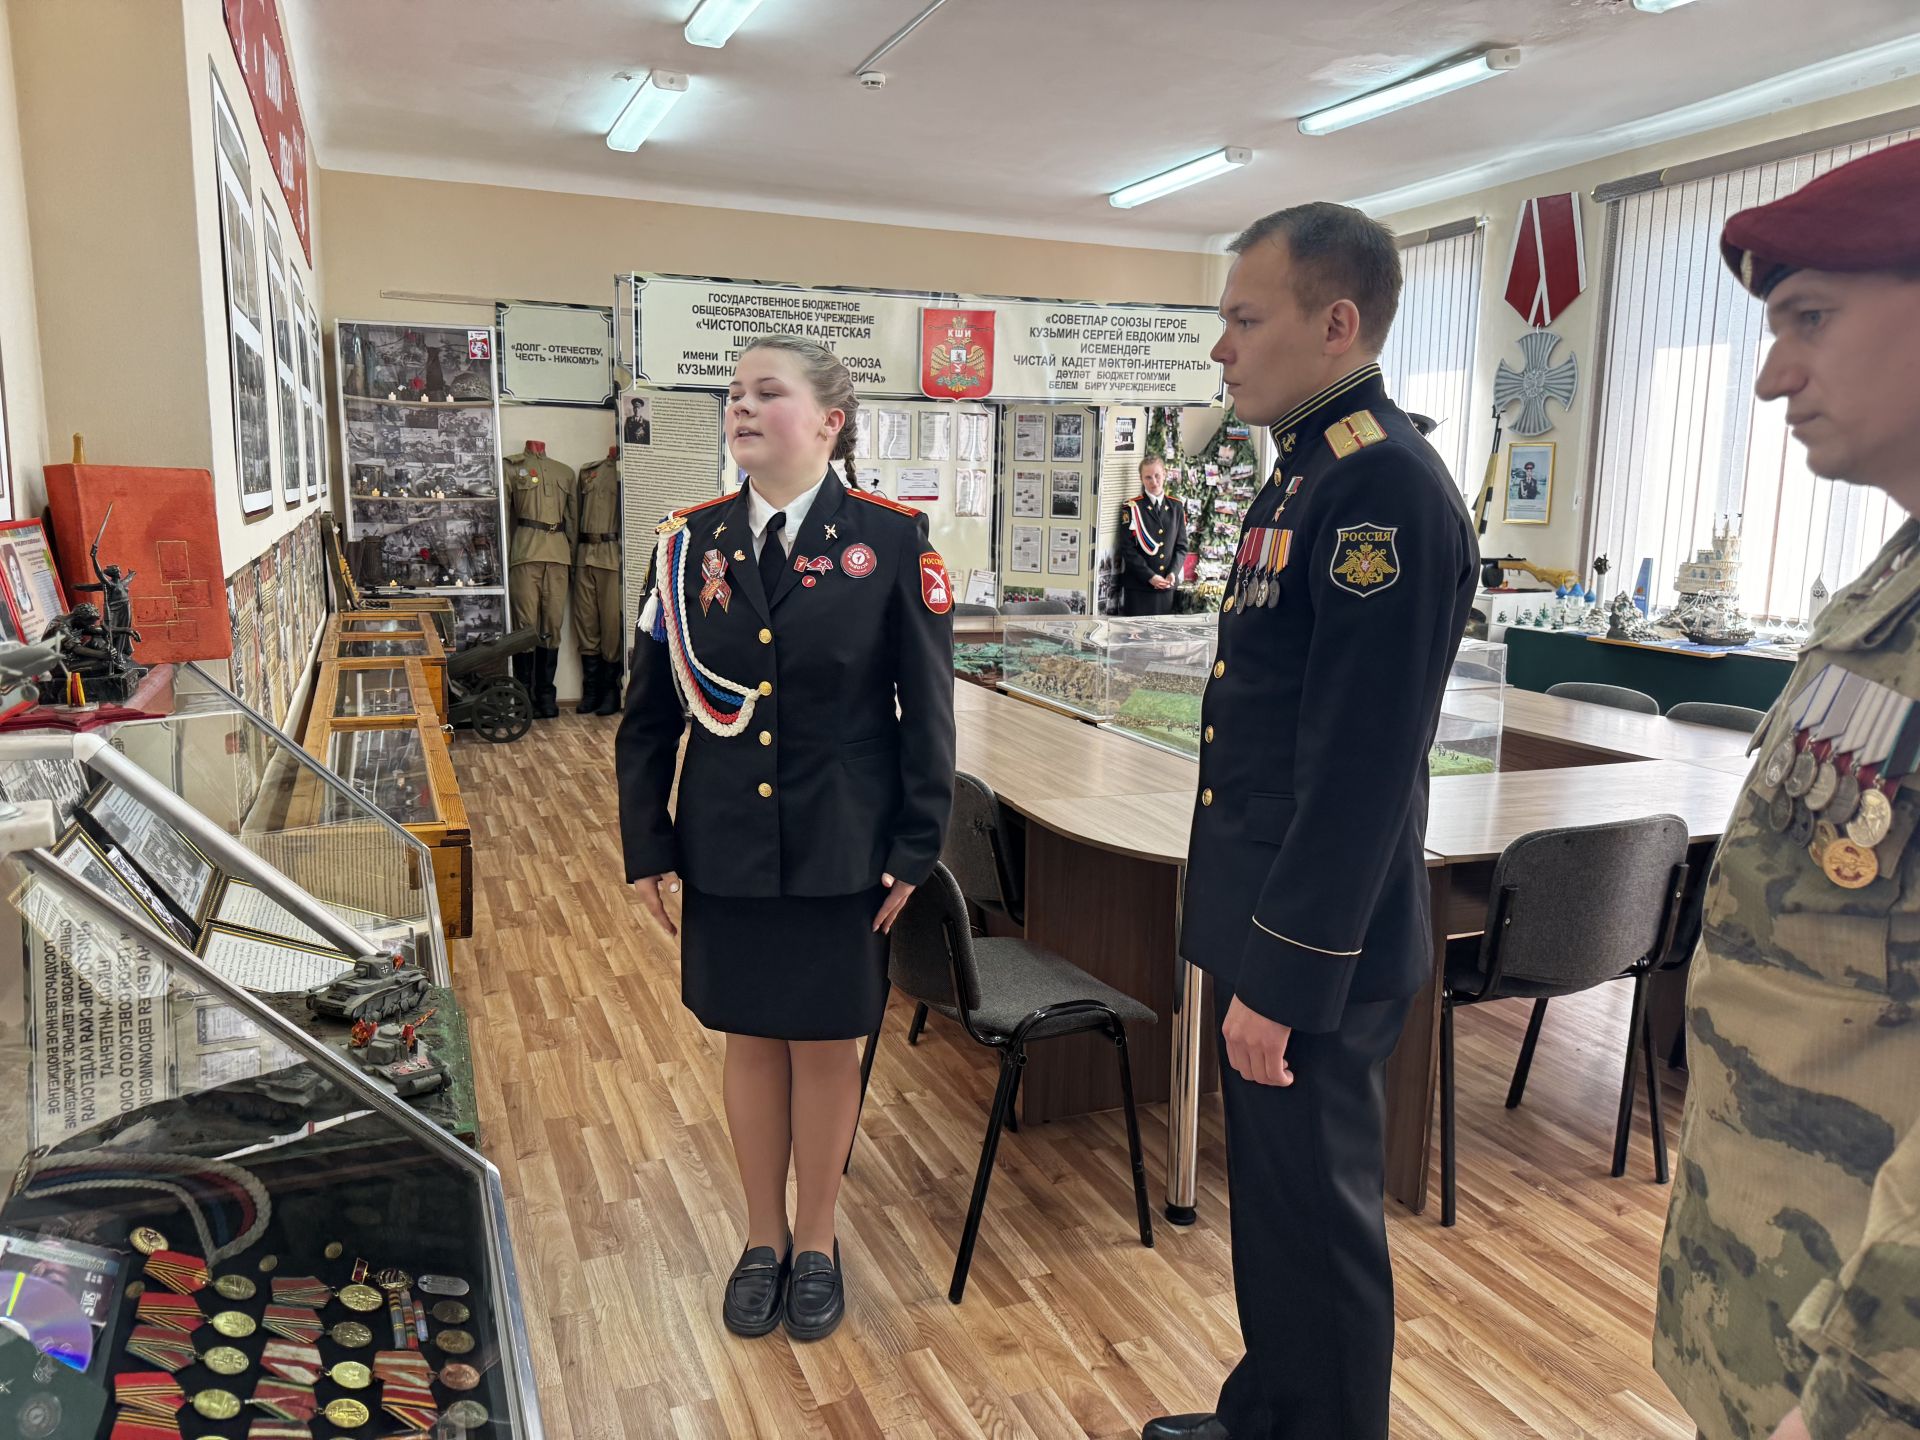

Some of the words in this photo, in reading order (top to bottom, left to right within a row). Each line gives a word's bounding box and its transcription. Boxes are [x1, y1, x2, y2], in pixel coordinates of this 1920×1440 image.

[708, 293, 800, 308] ГОСУДАРСТВЕННОЕ
[803, 299, 861, 312] БЮДЖЕТНОЕ
[692, 305, 813, 321] ОБЩЕОБРАЗОВАТЕЛЬНОЕ
[814, 312, 875, 325] УЧРЕЖДЕНИЕ
[1045, 313, 1108, 326] «СОВЕТЛАР
[1110, 316, 1152, 328] СОЮЗЫ
[1154, 318, 1187, 329] ГЕРОЕ
[696, 318, 804, 335] «ЧИСТОПОЛЬСКАЯ
[806, 325, 871, 339] КАДЕТСКАЯ
[947, 329, 972, 338] КШИ
[1029, 327, 1080, 339] КУЗЬМИН
[1082, 327, 1123, 341] СЕРГЕЙ
[1126, 331, 1176, 344] ЕВДОКИМ
[1178, 333, 1200, 344] УЛЫ
[511, 342, 541, 352] «ДОЛГ
[548, 345, 604, 357] ОТЕЧЕСТВУ,
[682, 350, 718, 361] имени
[1081, 343, 1151, 356] ИСЕМЕНДӘГЕ
[515, 353, 546, 362] ЧЕСТЬ
[553, 355, 600, 365] НИКОМУ!»
[842, 356, 882, 369] СОЮЗА
[1013, 353, 1056, 367] ЧИСТАЙ
[1061, 356, 1097, 369] КАДЕТ
[1098, 358, 1212, 371] МӘКТӘП-ИНТЕРНАТЫ»
[1096, 370, 1134, 381] БЮДЖЕТ
[1136, 371, 1171, 381] ГОМУМИ
[1048, 381, 1079, 390] БЕЛЕМ
[1109, 382, 1177, 393] УЧРЕЖДЕНИЕСЕ
[1340, 532, 1392, 542] РОССИЯ
[922, 557, 945, 566] РОССИ
